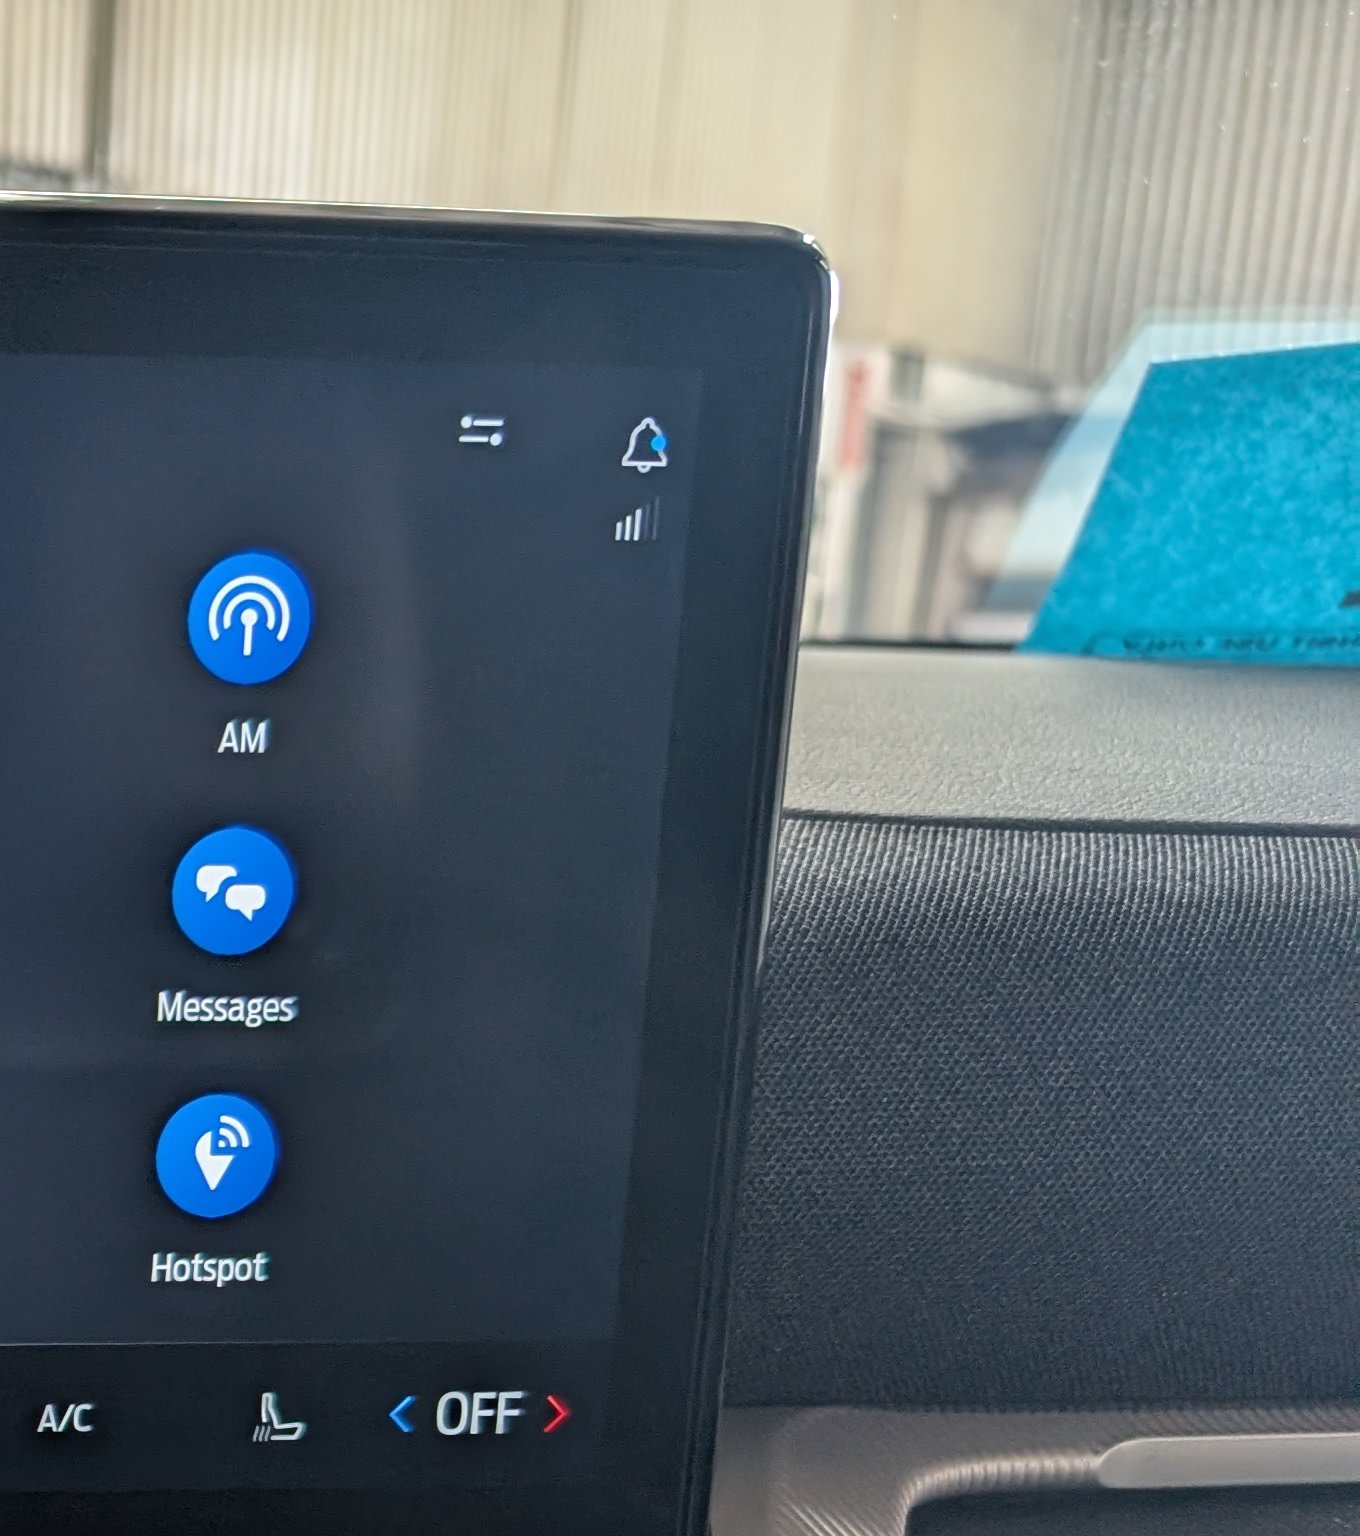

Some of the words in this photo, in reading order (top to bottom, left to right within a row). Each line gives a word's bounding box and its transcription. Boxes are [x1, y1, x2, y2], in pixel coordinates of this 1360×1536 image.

[218, 721, 269, 755] AM
[158, 991, 298, 1029] Messages
[151, 1253, 270, 1289] Hotspot
[37, 1404, 94, 1434] A/C
[437, 1391, 526, 1437] OFF
